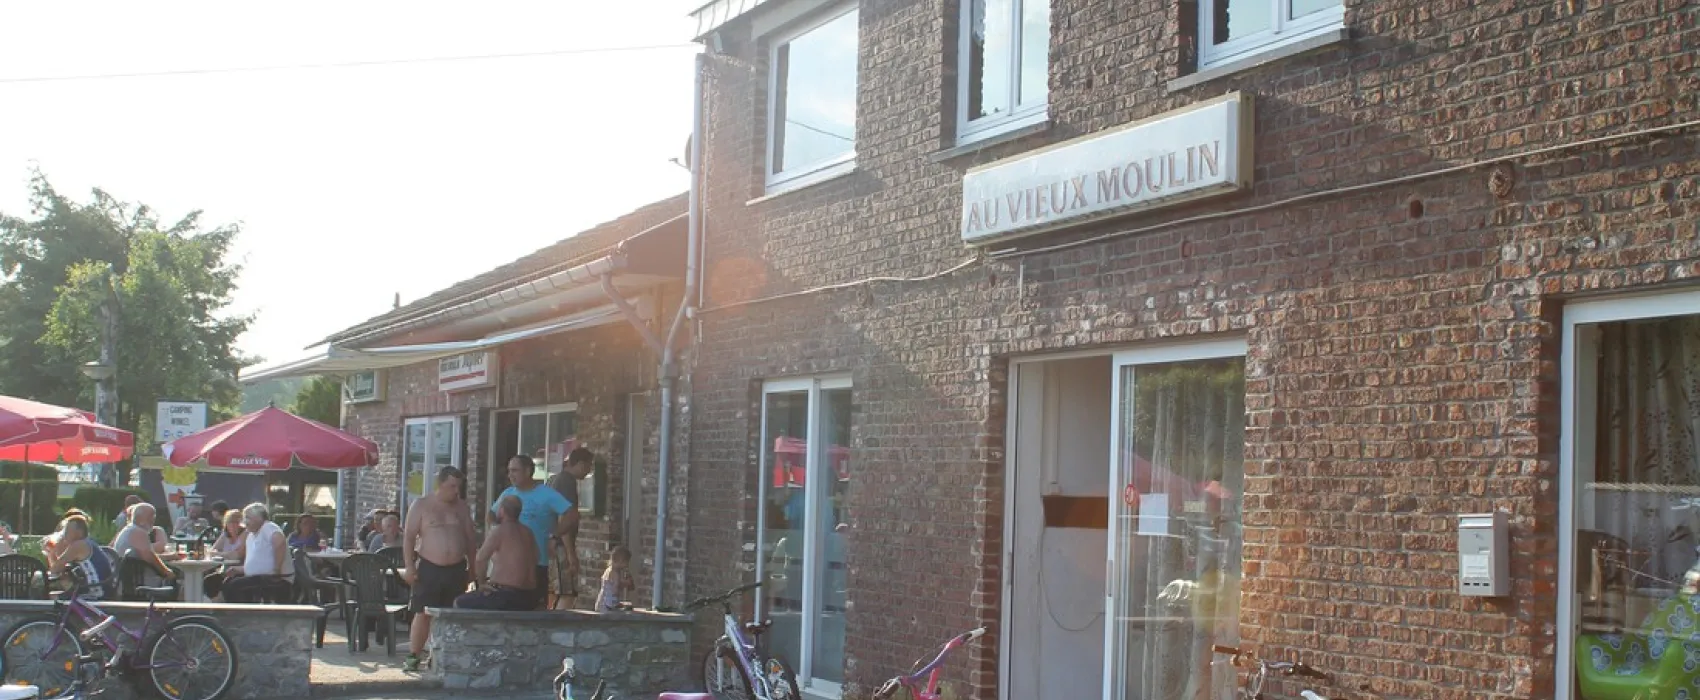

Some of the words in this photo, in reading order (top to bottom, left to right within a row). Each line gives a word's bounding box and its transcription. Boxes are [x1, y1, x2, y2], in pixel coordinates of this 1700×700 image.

[966, 198, 999, 233] AU
[1006, 174, 1088, 223] VIEUX
[1096, 140, 1220, 204] MOULIN
